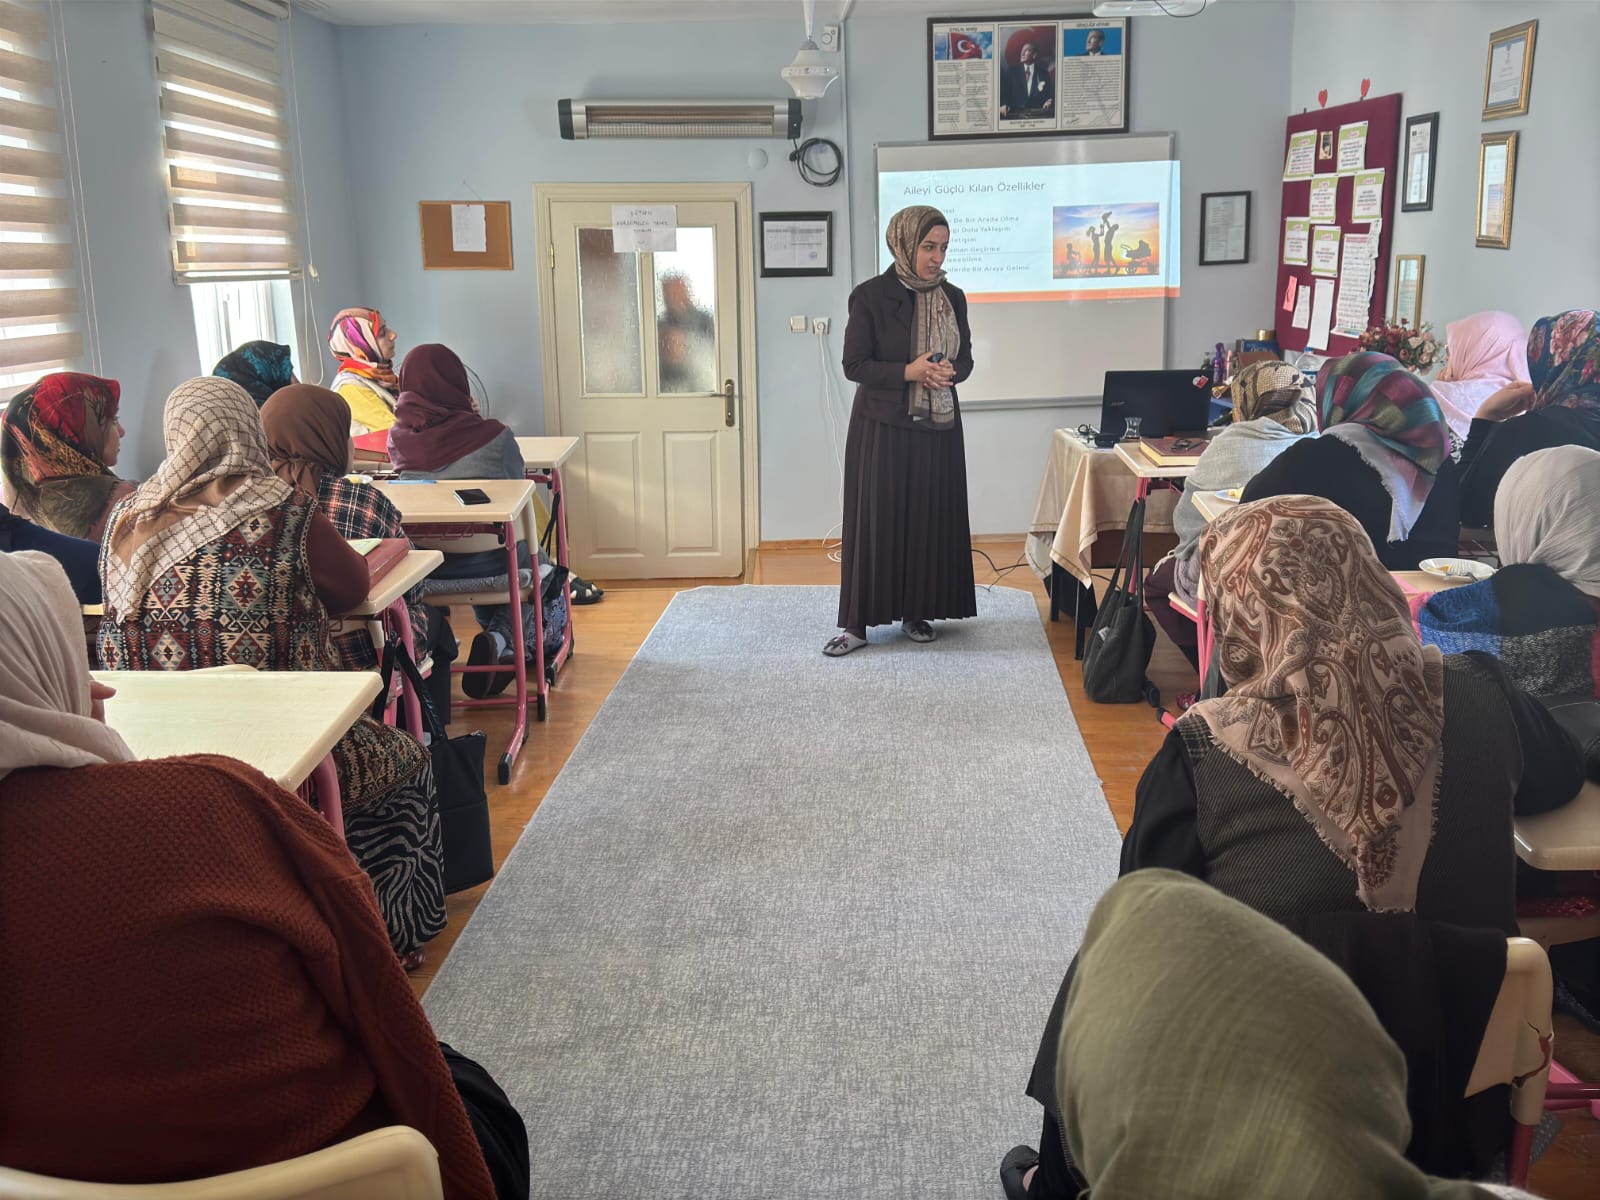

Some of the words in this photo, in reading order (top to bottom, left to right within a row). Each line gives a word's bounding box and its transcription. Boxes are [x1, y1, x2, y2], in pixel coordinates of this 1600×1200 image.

[903, 186, 931, 196] Aileyi
[935, 184, 964, 195] Güçlü
[968, 183, 994, 193] Kılan
[997, 181, 1046, 191] Özellikler
